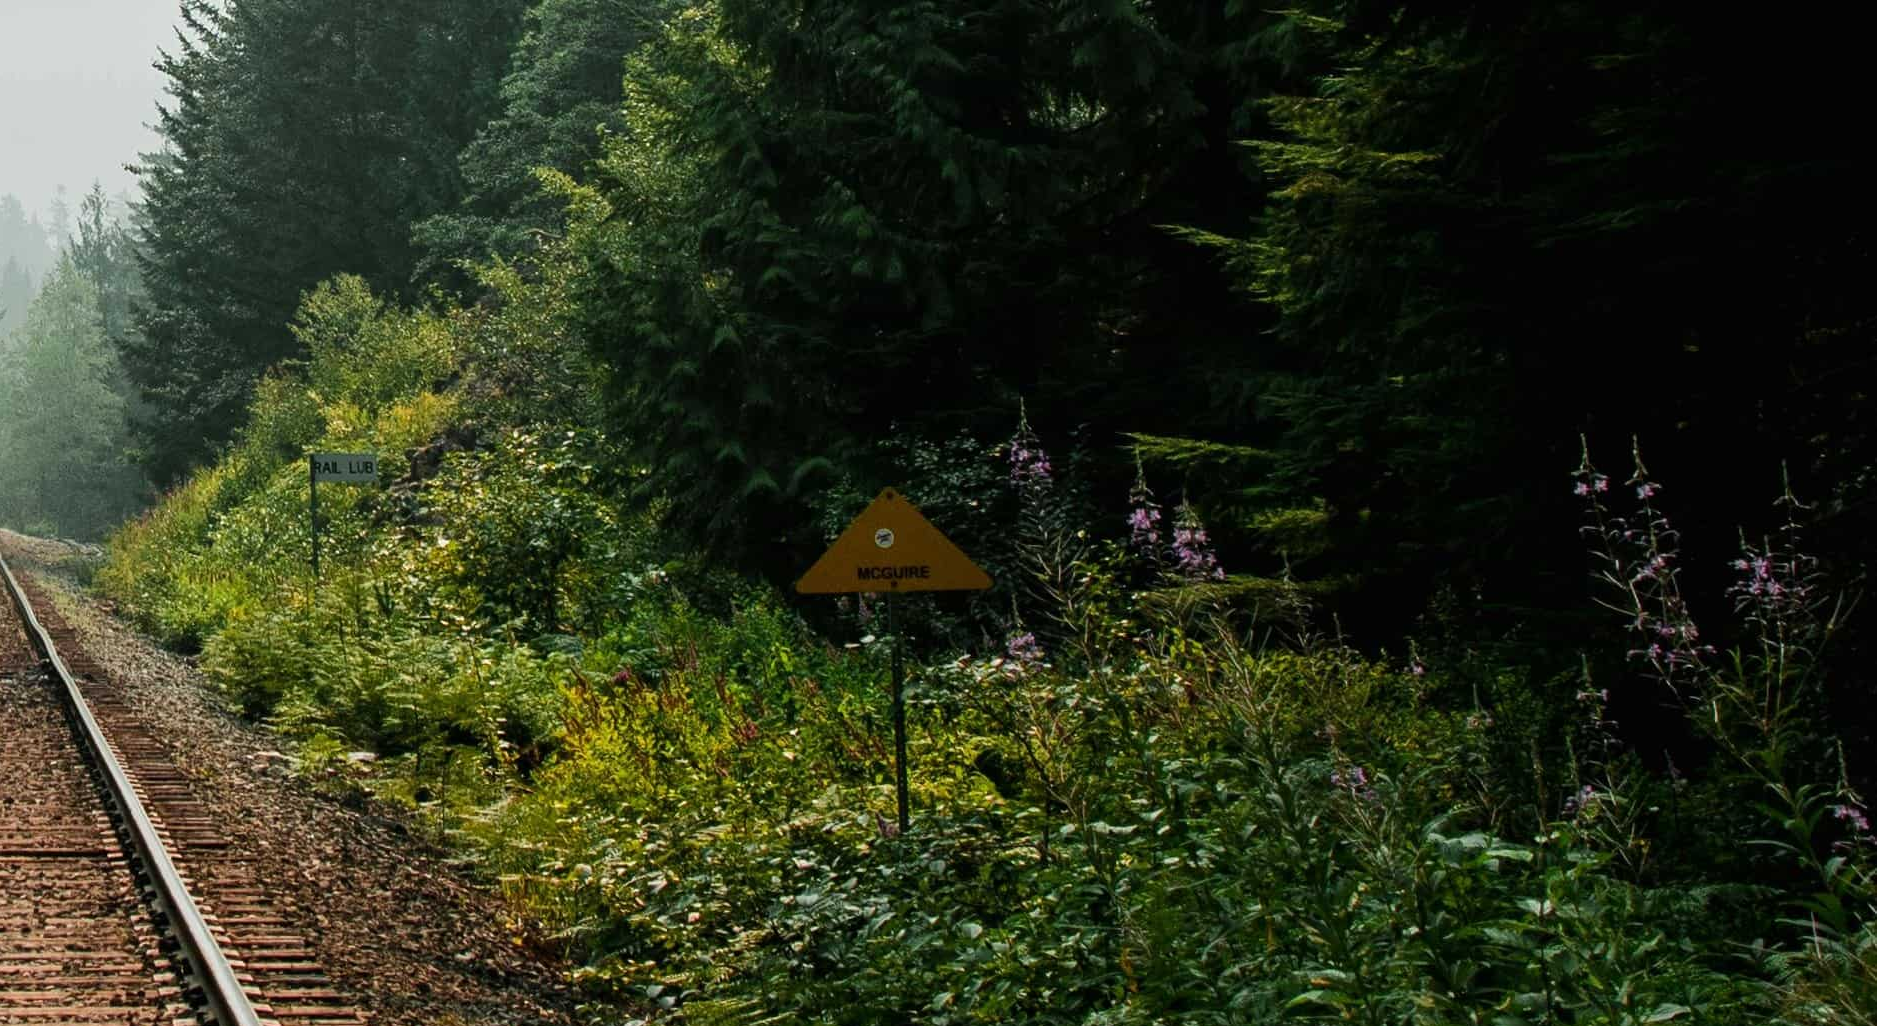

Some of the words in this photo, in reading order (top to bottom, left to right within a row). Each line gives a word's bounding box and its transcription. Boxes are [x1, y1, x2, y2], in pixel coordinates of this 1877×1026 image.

[314, 461, 342, 474] RAIL
[348, 461, 374, 474] LUB
[857, 566, 931, 580] MCGUIRE
